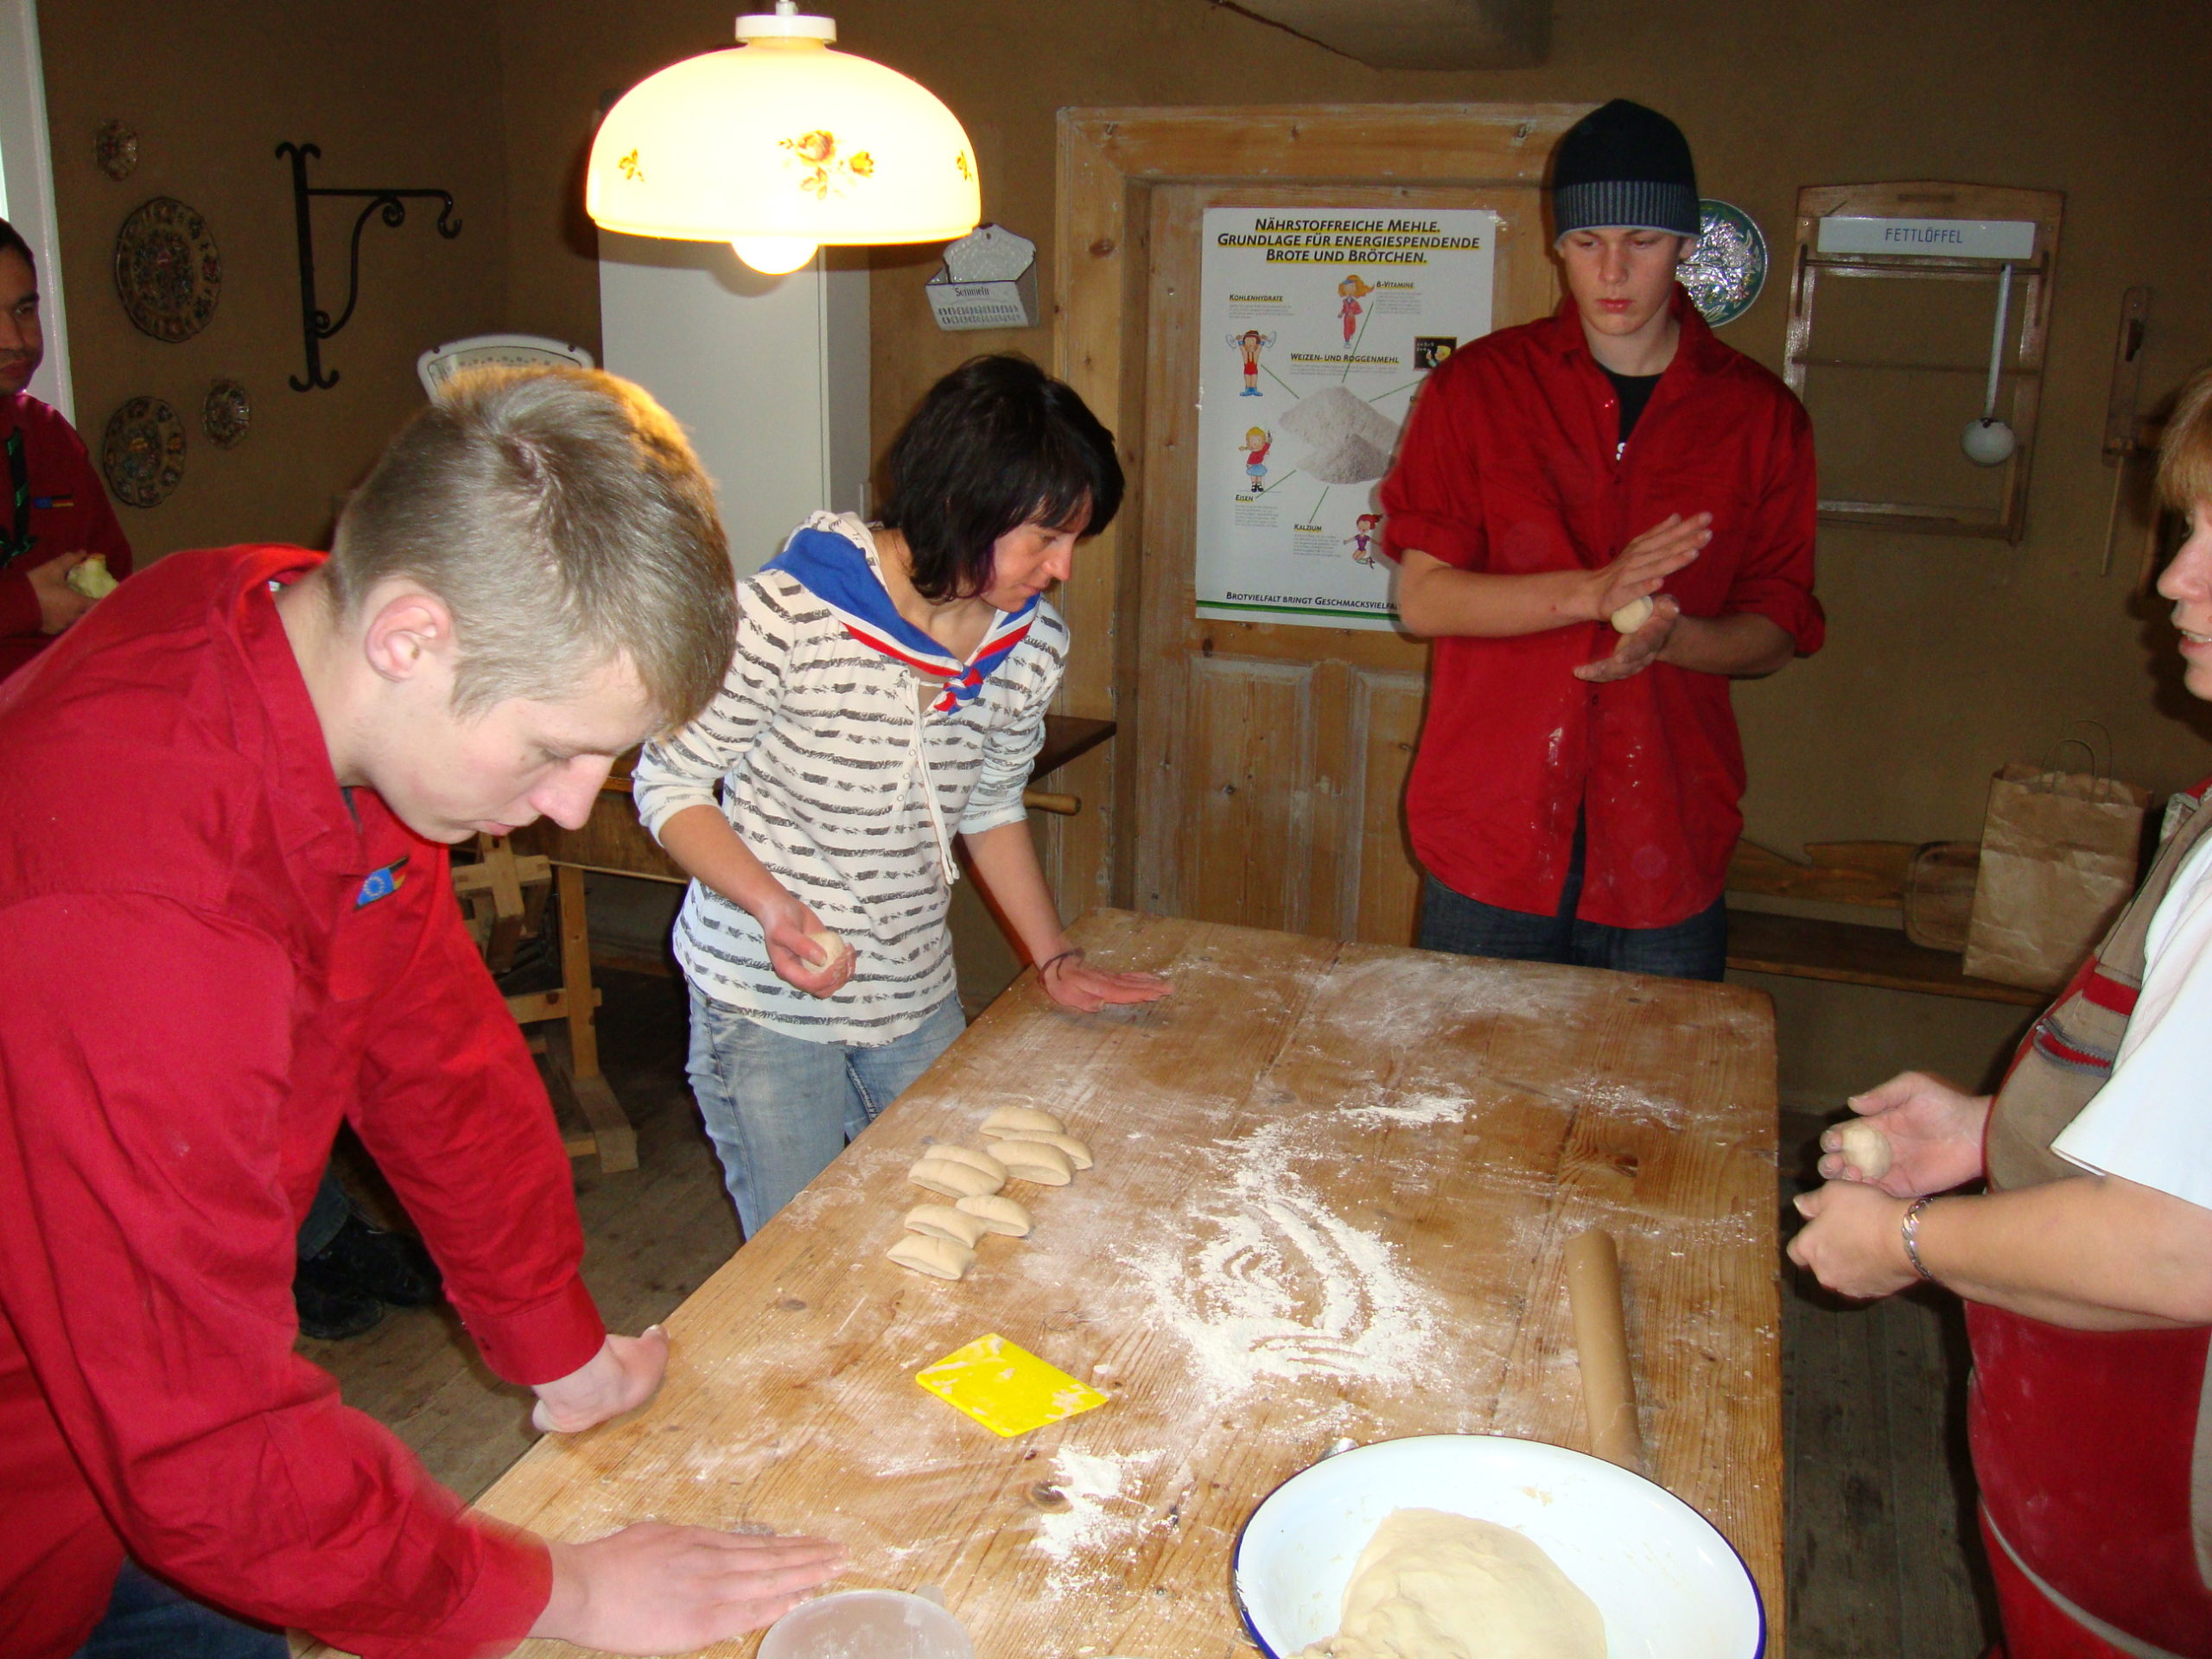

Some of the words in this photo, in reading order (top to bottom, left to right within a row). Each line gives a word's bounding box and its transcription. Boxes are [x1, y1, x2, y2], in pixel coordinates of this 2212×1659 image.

[1255, 217, 1383, 232] NÄHRSTOFFREICHE
[1388, 219, 1440, 233] MEHLE.
[1217, 233, 1302, 247] GRUNDLAGE
[1305, 232, 1331, 247] FÜR
[1335, 236, 1480, 249] ENERGIESPENDENDE
[1885, 226, 1963, 244] FETTLÖFFEL
[1266, 249, 1310, 263] BROTE
[1314, 251, 1344, 263] UND
[1348, 249, 1427, 264] BRÖTCHEN.
[1376, 281, 1414, 289] B-VITAMINE
[1230, 294, 1283, 302] KOHLENHYDRATE
[1290, 353, 1323, 362] WEIZEN-
[1325, 354, 1342, 363] UND
[1343, 354, 1400, 364] ROGGENMEHL
[1225, 591, 1281, 603] BROTVIELFALT
[1283, 596, 1313, 605] BRINGT
